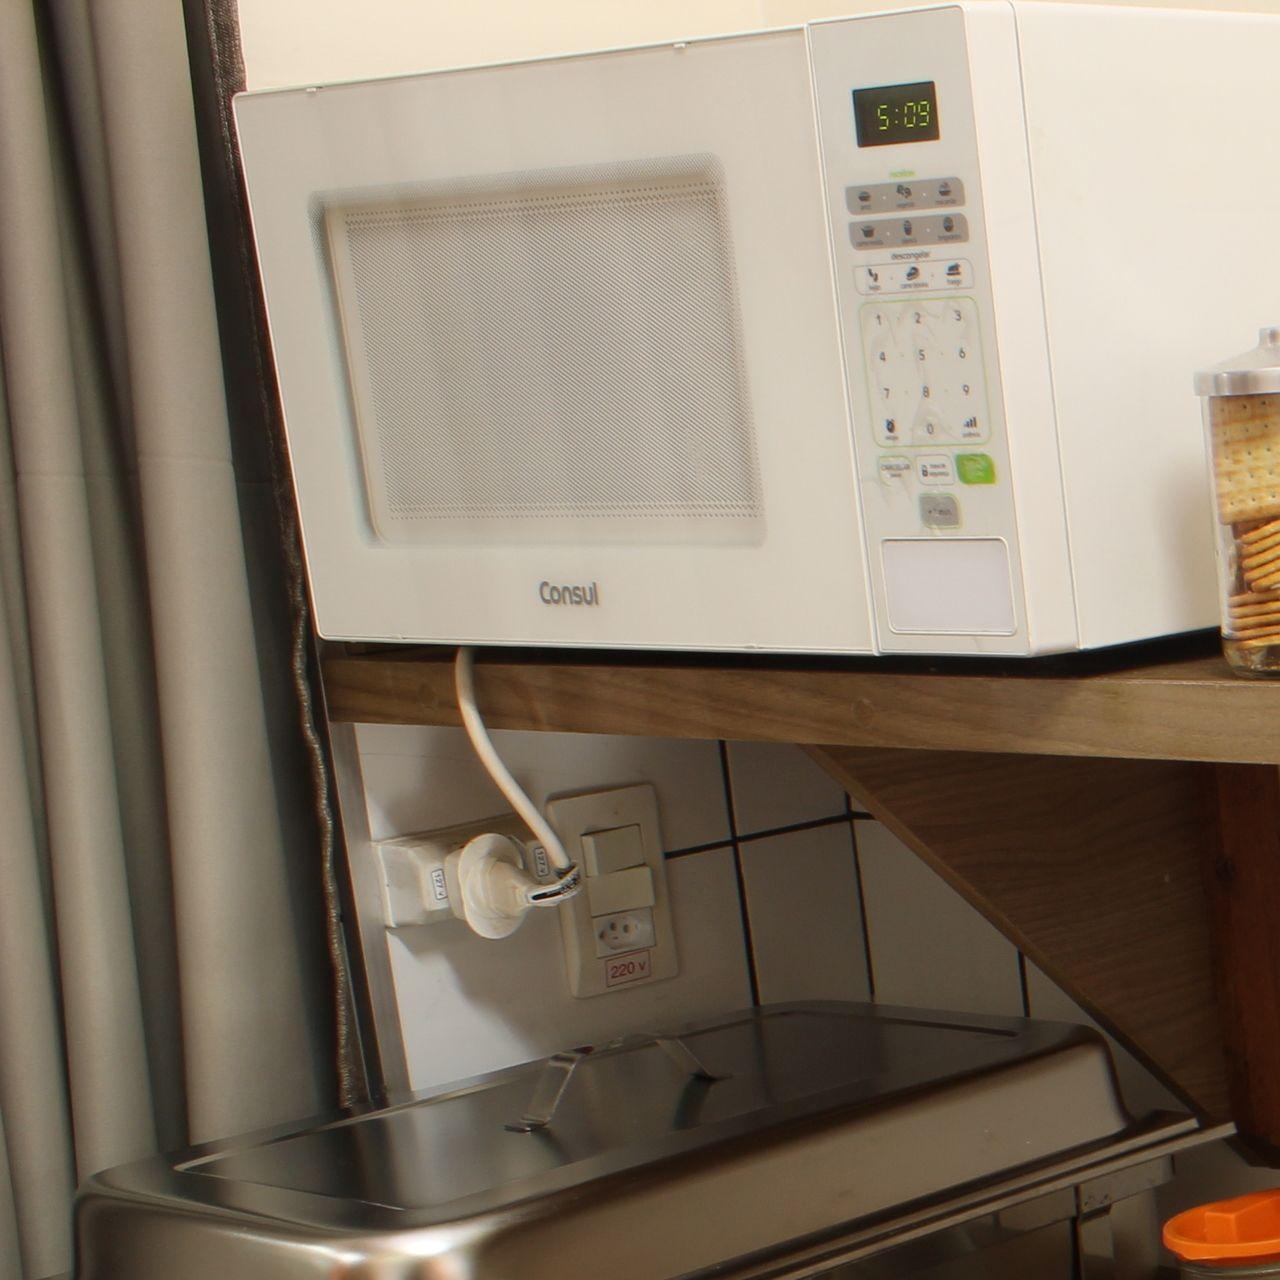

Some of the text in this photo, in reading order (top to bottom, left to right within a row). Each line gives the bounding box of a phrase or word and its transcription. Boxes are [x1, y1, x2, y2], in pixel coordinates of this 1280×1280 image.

[878, 101, 930, 130] 5:09
[914, 312, 922, 324] 2
[954, 309, 962, 321] 3
[880, 347, 966, 362] 4 5 6
[883, 384, 970, 399] 7 8 9
[539, 580, 600, 606] Consul
[610, 962, 635, 979] 220
